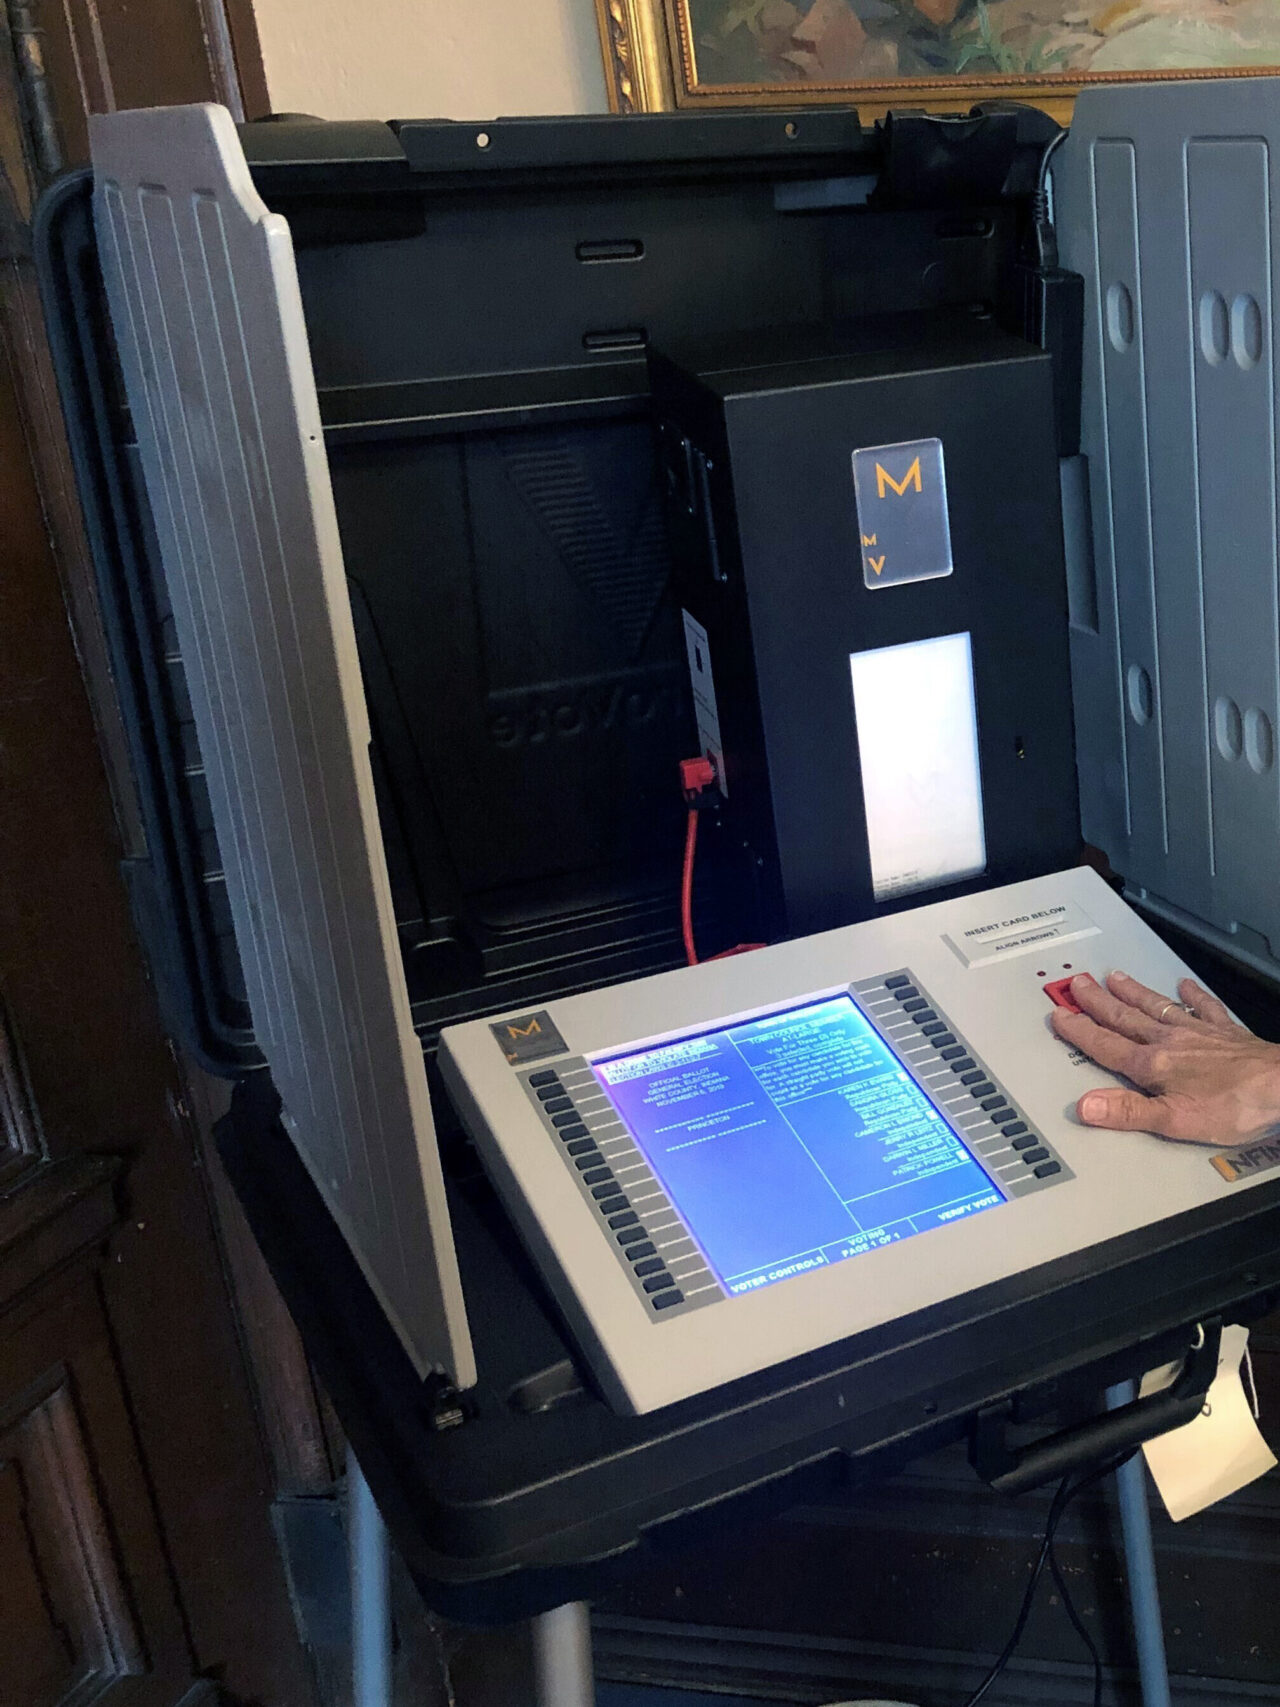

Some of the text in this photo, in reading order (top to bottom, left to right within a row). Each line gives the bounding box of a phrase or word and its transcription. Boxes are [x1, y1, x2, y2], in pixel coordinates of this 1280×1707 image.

[876, 456, 922, 498] M
[868, 556, 886, 577] V
[964, 905, 1066, 937] INSERT CARD BELOW
[995, 931, 1055, 951] ALIGN ARROWS
[506, 1018, 542, 1039] M
[647, 1072, 719, 1095] GENERAL ELECTION
[648, 1067, 710, 1087] OFFICIAL BALLOT
[643, 1094, 666, 1103] WHITE
[656, 1091, 699, 1106] NOVEMBER
[687, 1115, 730, 1130] PRINCETON
[892, 1162, 923, 1175] PATRICK
[937, 1195, 999, 1220] VERIFY VOTE
[842, 1243, 869, 1256] PAGE
[878, 1234, 893, 1243] OF
[848, 1229, 885, 1245] VOTING
[731, 1256, 824, 1292] VOTER CONTROLS
